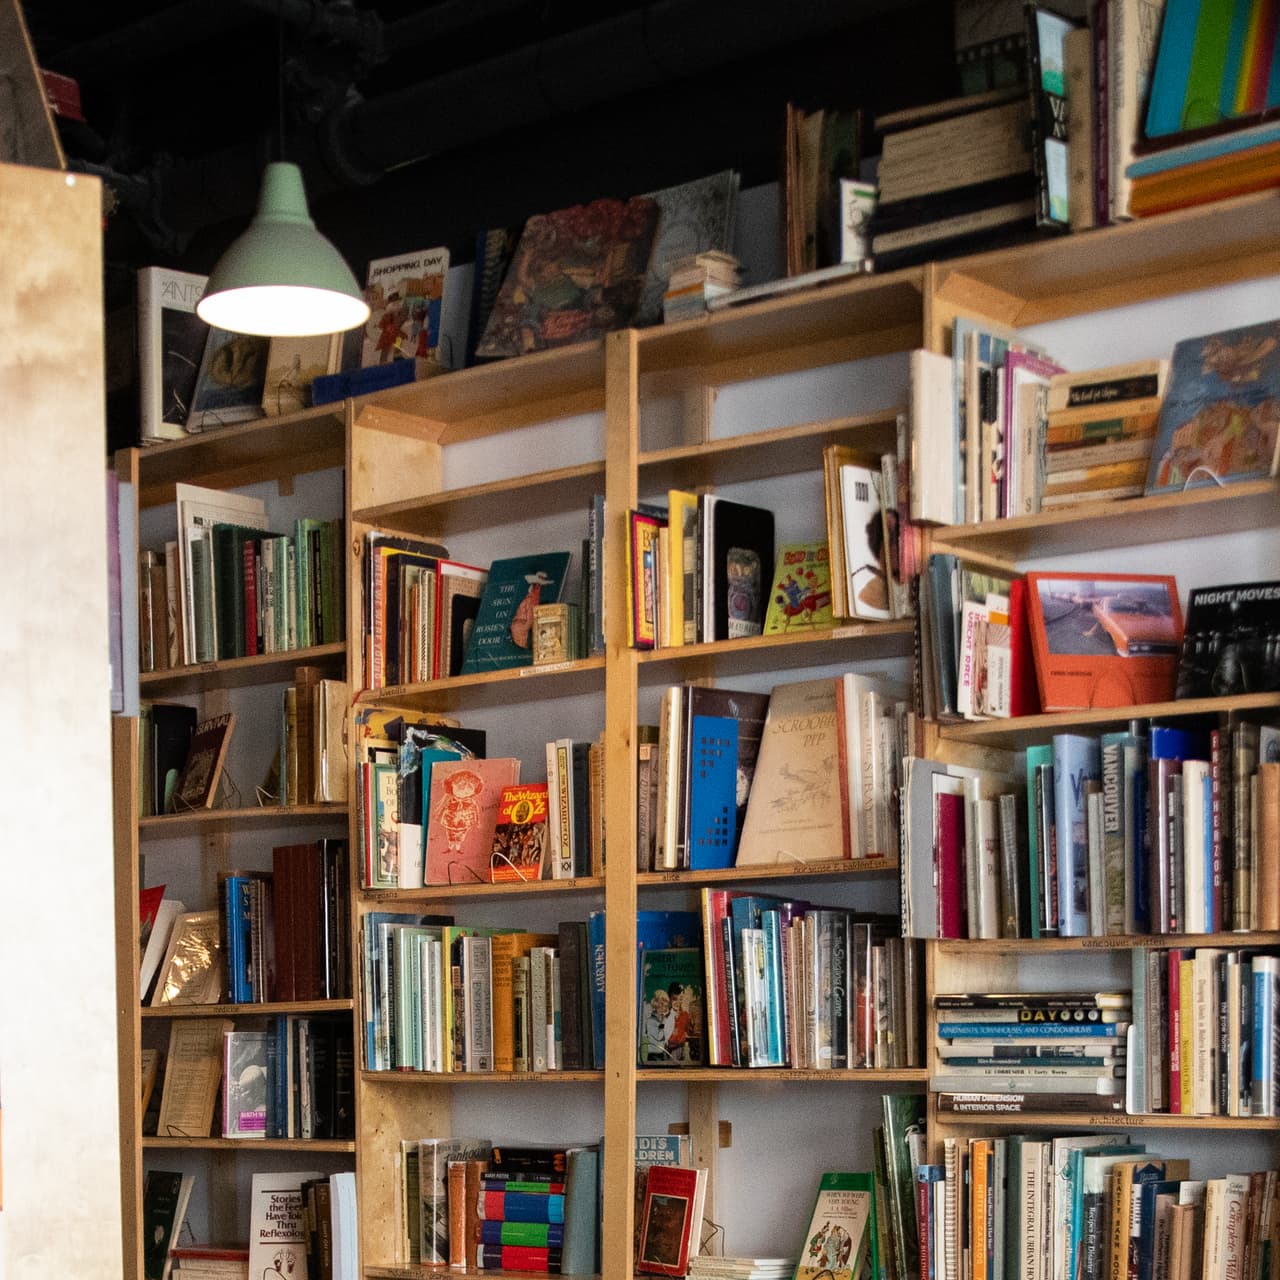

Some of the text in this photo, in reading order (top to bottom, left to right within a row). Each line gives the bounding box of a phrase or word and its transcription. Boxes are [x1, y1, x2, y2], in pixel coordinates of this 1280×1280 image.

[370, 256, 444, 278] SHOPPING DAY
[499, 584, 515, 594] THE
[1194, 589, 1235, 606] NIGHT
[495, 611, 508, 619] ON
[477, 637, 501, 645] DOOR
[803, 732, 826, 748] PIP
[1103, 743, 1120, 833] VANCOUVER
[504, 790, 548, 801] The Wizard
[503, 800, 547, 825] of Oz
[1212, 801, 1220, 887] HERZOG
[662, 871, 681, 882] alice
[1081, 937, 1166, 949] vancouver written
[1021, 1010, 1057, 1021] DAY
[1089, 1117, 1144, 1126] architecture
[271, 1194, 300, 1204] Stories
[1027, 1188, 1035, 1233] INTEGRAL
[276, 1220, 297, 1231] Thru
[1088, 1207, 1097, 1233] Recipes
[1026, 1235, 1035, 1264] URBAN
[1087, 1245, 1096, 1273] Disaster
